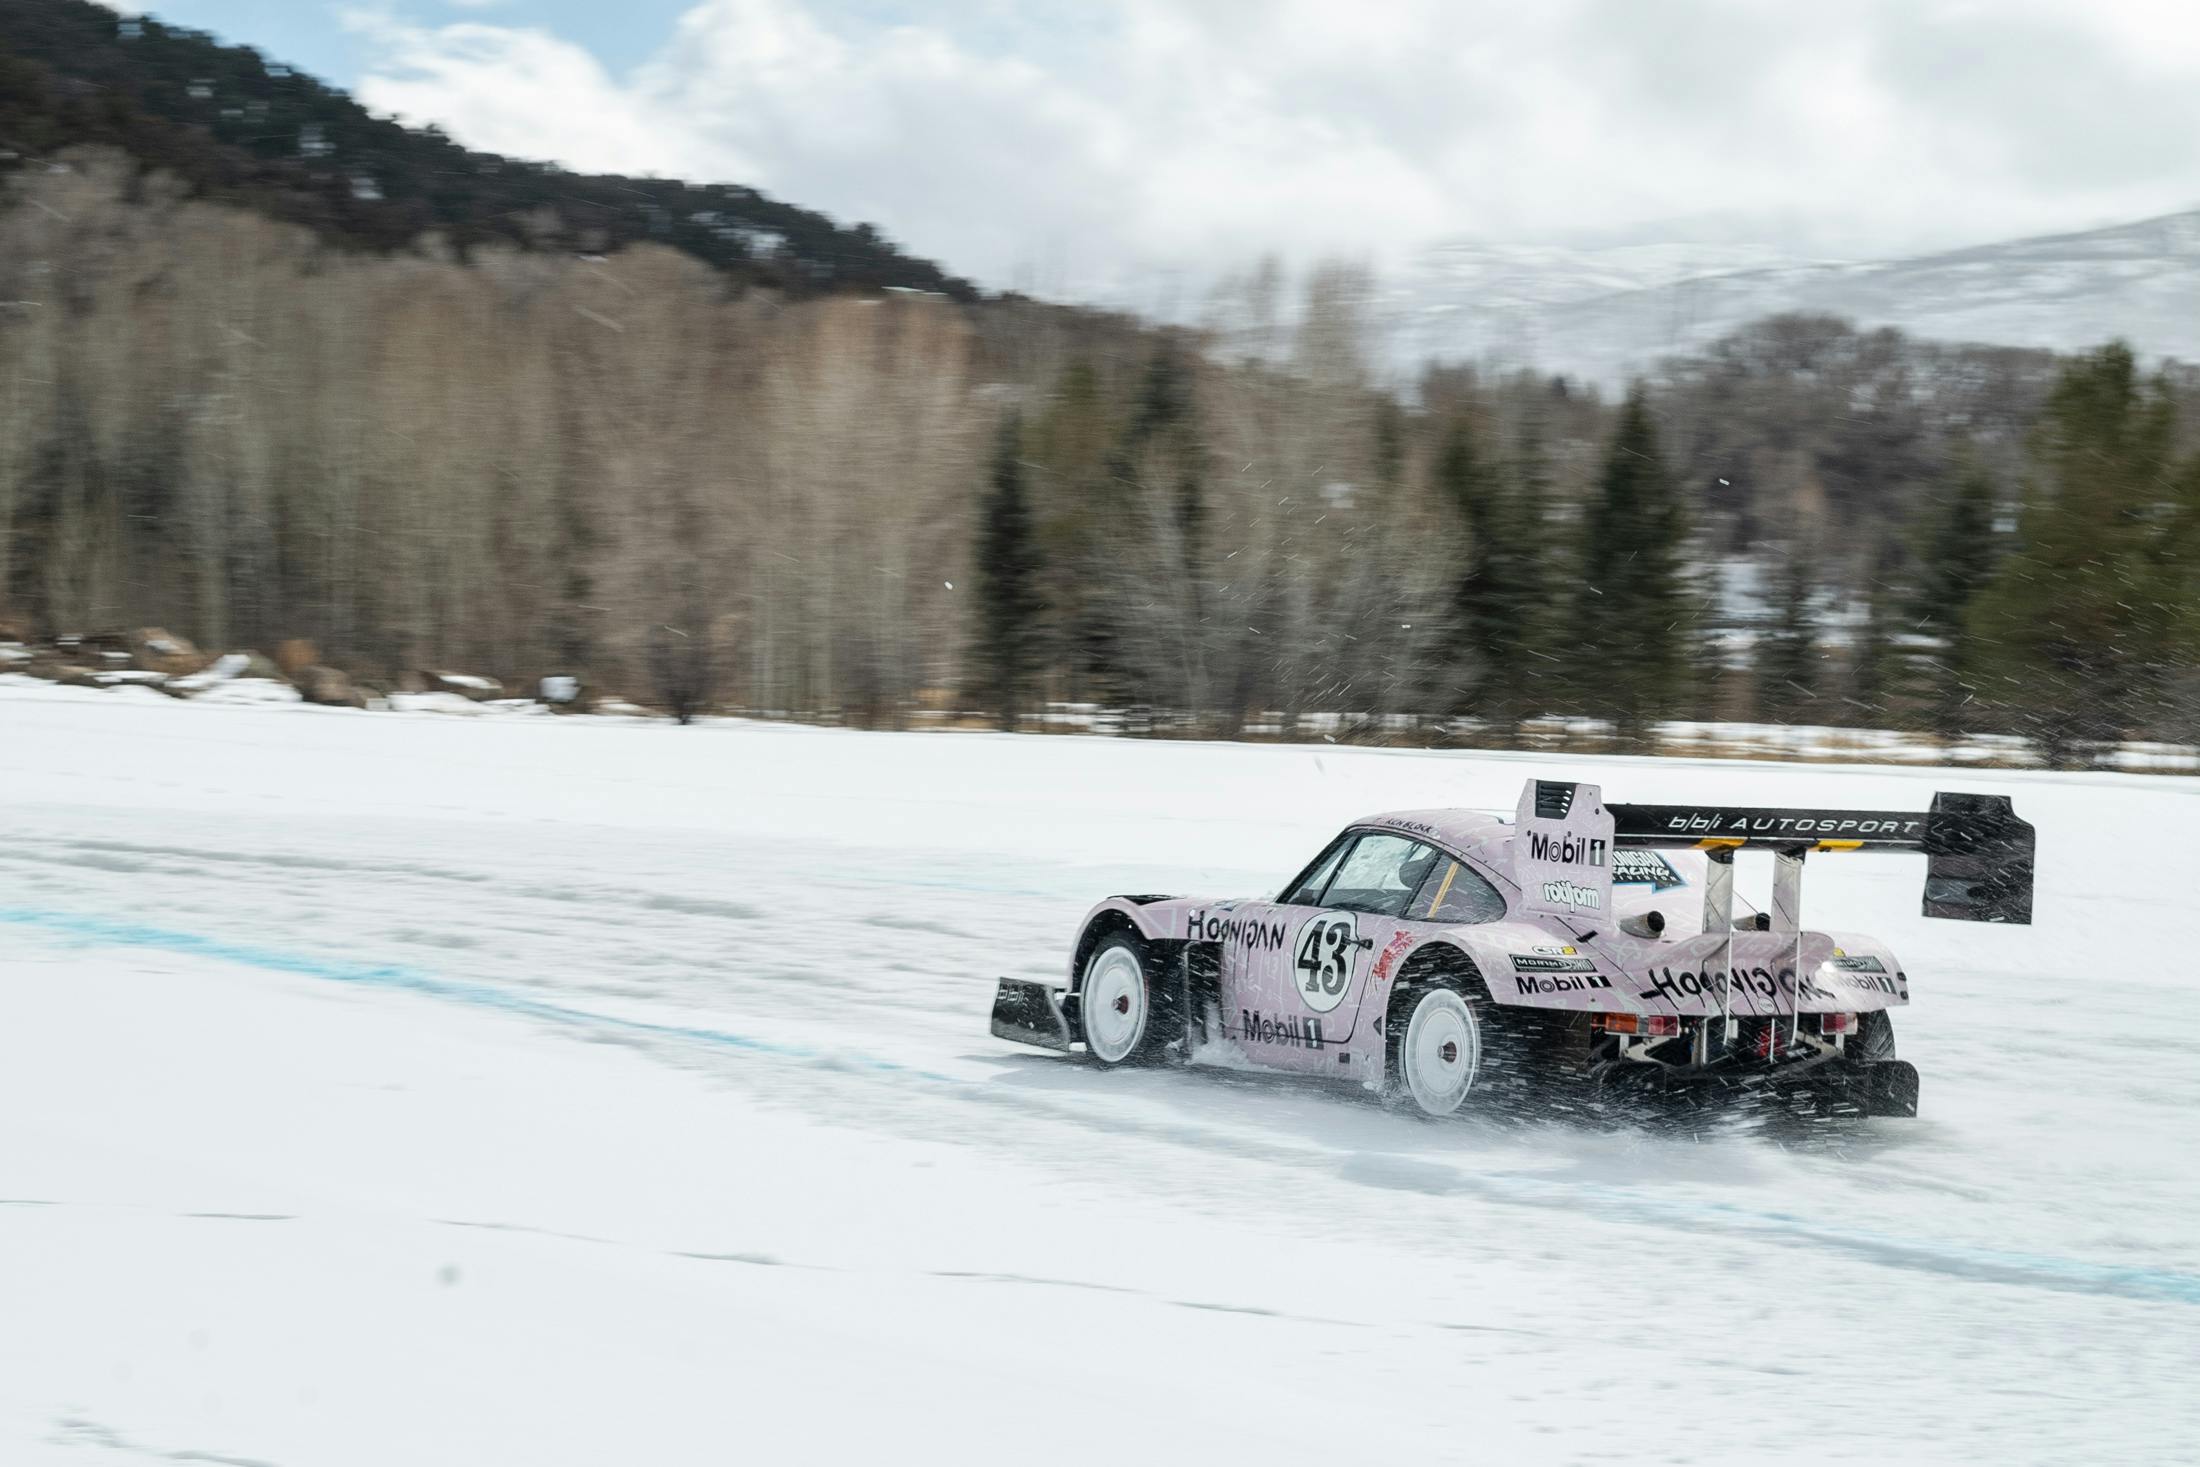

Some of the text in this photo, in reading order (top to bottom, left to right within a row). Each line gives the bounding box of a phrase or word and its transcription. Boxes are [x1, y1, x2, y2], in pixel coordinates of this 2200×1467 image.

[1730, 817, 1920, 834] AUTOSPORT
[1531, 832, 1604, 866] Mobil 1
[1543, 880, 1600, 913] rotiform
[1187, 909, 1287, 952] HOONIGAN
[1297, 919, 1352, 996] 43
[1515, 976, 1609, 995] Mobil 1
[1243, 1009, 1321, 1049] Mobil 1
